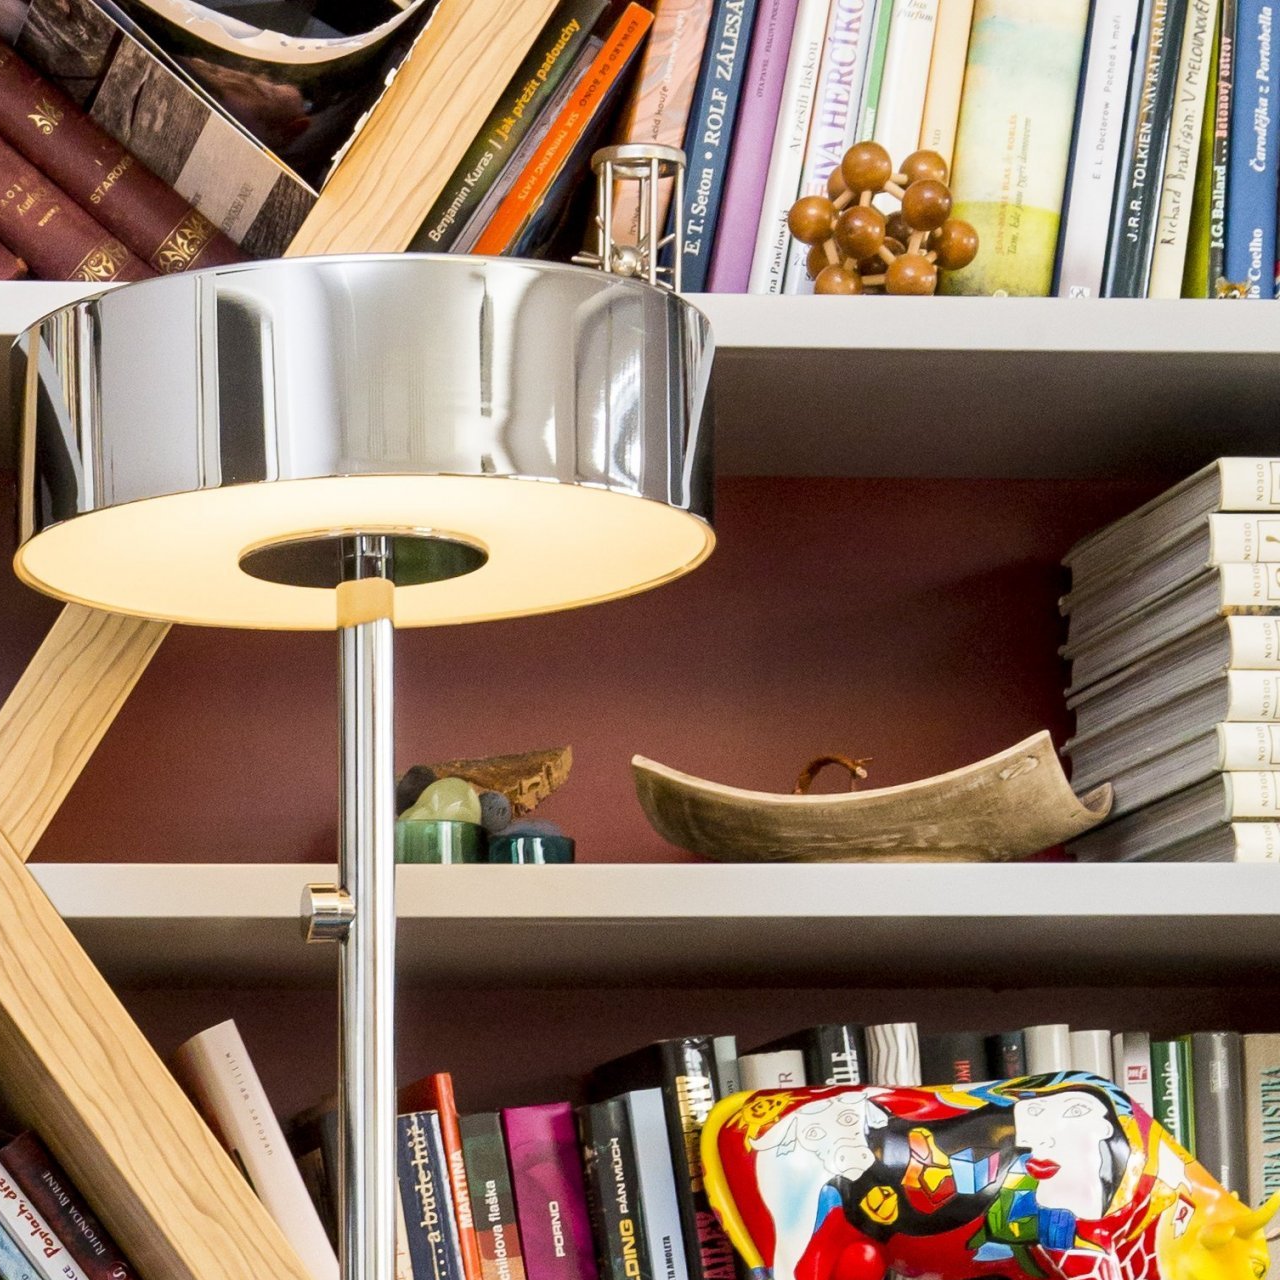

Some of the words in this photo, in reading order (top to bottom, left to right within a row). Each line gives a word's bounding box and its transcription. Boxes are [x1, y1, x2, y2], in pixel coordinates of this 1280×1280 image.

[1255, 5, 1272, 82] Portobella
[428, 180, 473, 243] Benjamin
[464, 150, 494, 188] Kuras
[495, 114, 517, 141] Jak
[512, 76, 540, 120] přežít
[537, 18, 582, 86] padouchy
[703, 88, 727, 147] ROLF
[1253, 104, 1270, 173] Čarodějka
[1133, 121, 1153, 188] TOLKIEN
[1247, 228, 1263, 281] Coelho
[546, 1201, 566, 1258] PORNO
